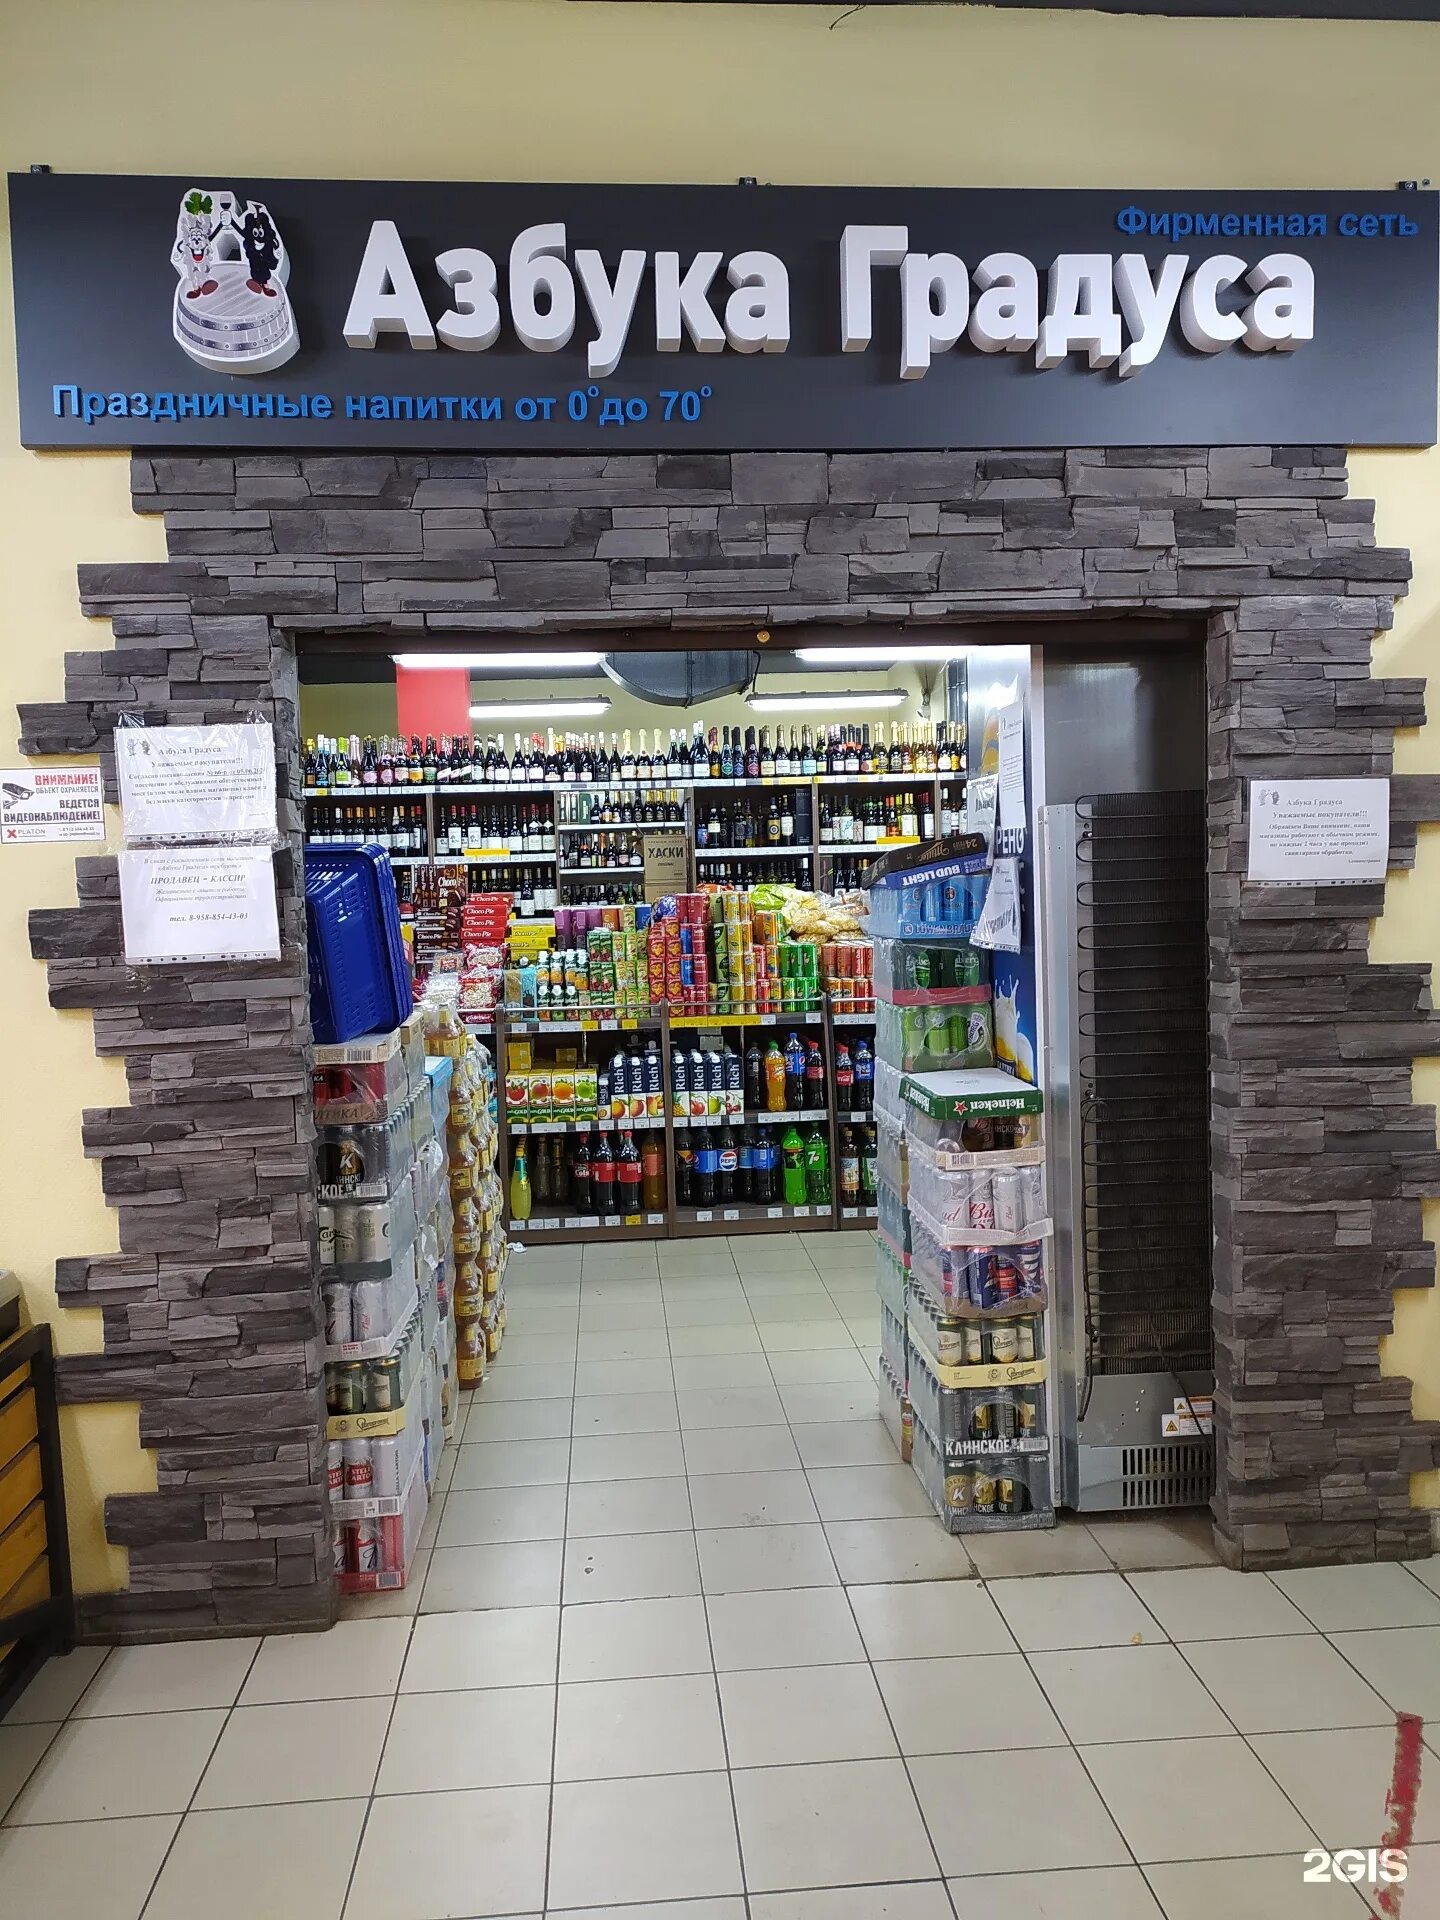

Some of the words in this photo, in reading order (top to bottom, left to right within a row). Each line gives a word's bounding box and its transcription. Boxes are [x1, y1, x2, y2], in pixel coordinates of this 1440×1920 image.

[1116, 205, 1328, 242] Фирменная
[1338, 211, 1419, 238] сеть
[342, 219, 791, 379] Азбука
[840, 224, 1315, 380] Градуса
[52, 384, 333, 425] Праздничные
[345, 393, 502, 422] напитки
[515, 395, 557, 422] от
[35, 773, 98, 785] ВНИМАНИЕ!
[36, 786, 59, 794] ОБЪЕКТ
[60, 785, 99, 793] ОХРАНЯЕТСЯ
[59, 798, 99, 809] ВЕДЕТСЯ
[1286, 799, 1312, 807] Азбука
[1313, 798, 1343, 806] Градуса
[4, 810, 101, 823] ВИДЕОНАБЛЮДЕНИЕ!
[647, 846, 684, 859] ХАСКИ
[901, 870, 935, 886] LIGHT
[935, 864, 961, 878] BUD
[150, 876, 200, 885] ПРОДАВЕЦ
[210, 874, 246, 883] КАССИР
[437, 877, 457, 887] Choco
[439, 888, 449, 898] Pie
[614, 1068, 625, 1093] Rich
[632, 1067, 643, 1092] Rich
[649, 1066, 660, 1091] Rich
[675, 1065, 686, 1090] Rich
[694, 1065, 704, 1090] Rich
[711, 1064, 722, 1089] Rich
[729, 1064, 740, 1089] Rich
[969, 1098, 1025, 1111] Heineken
